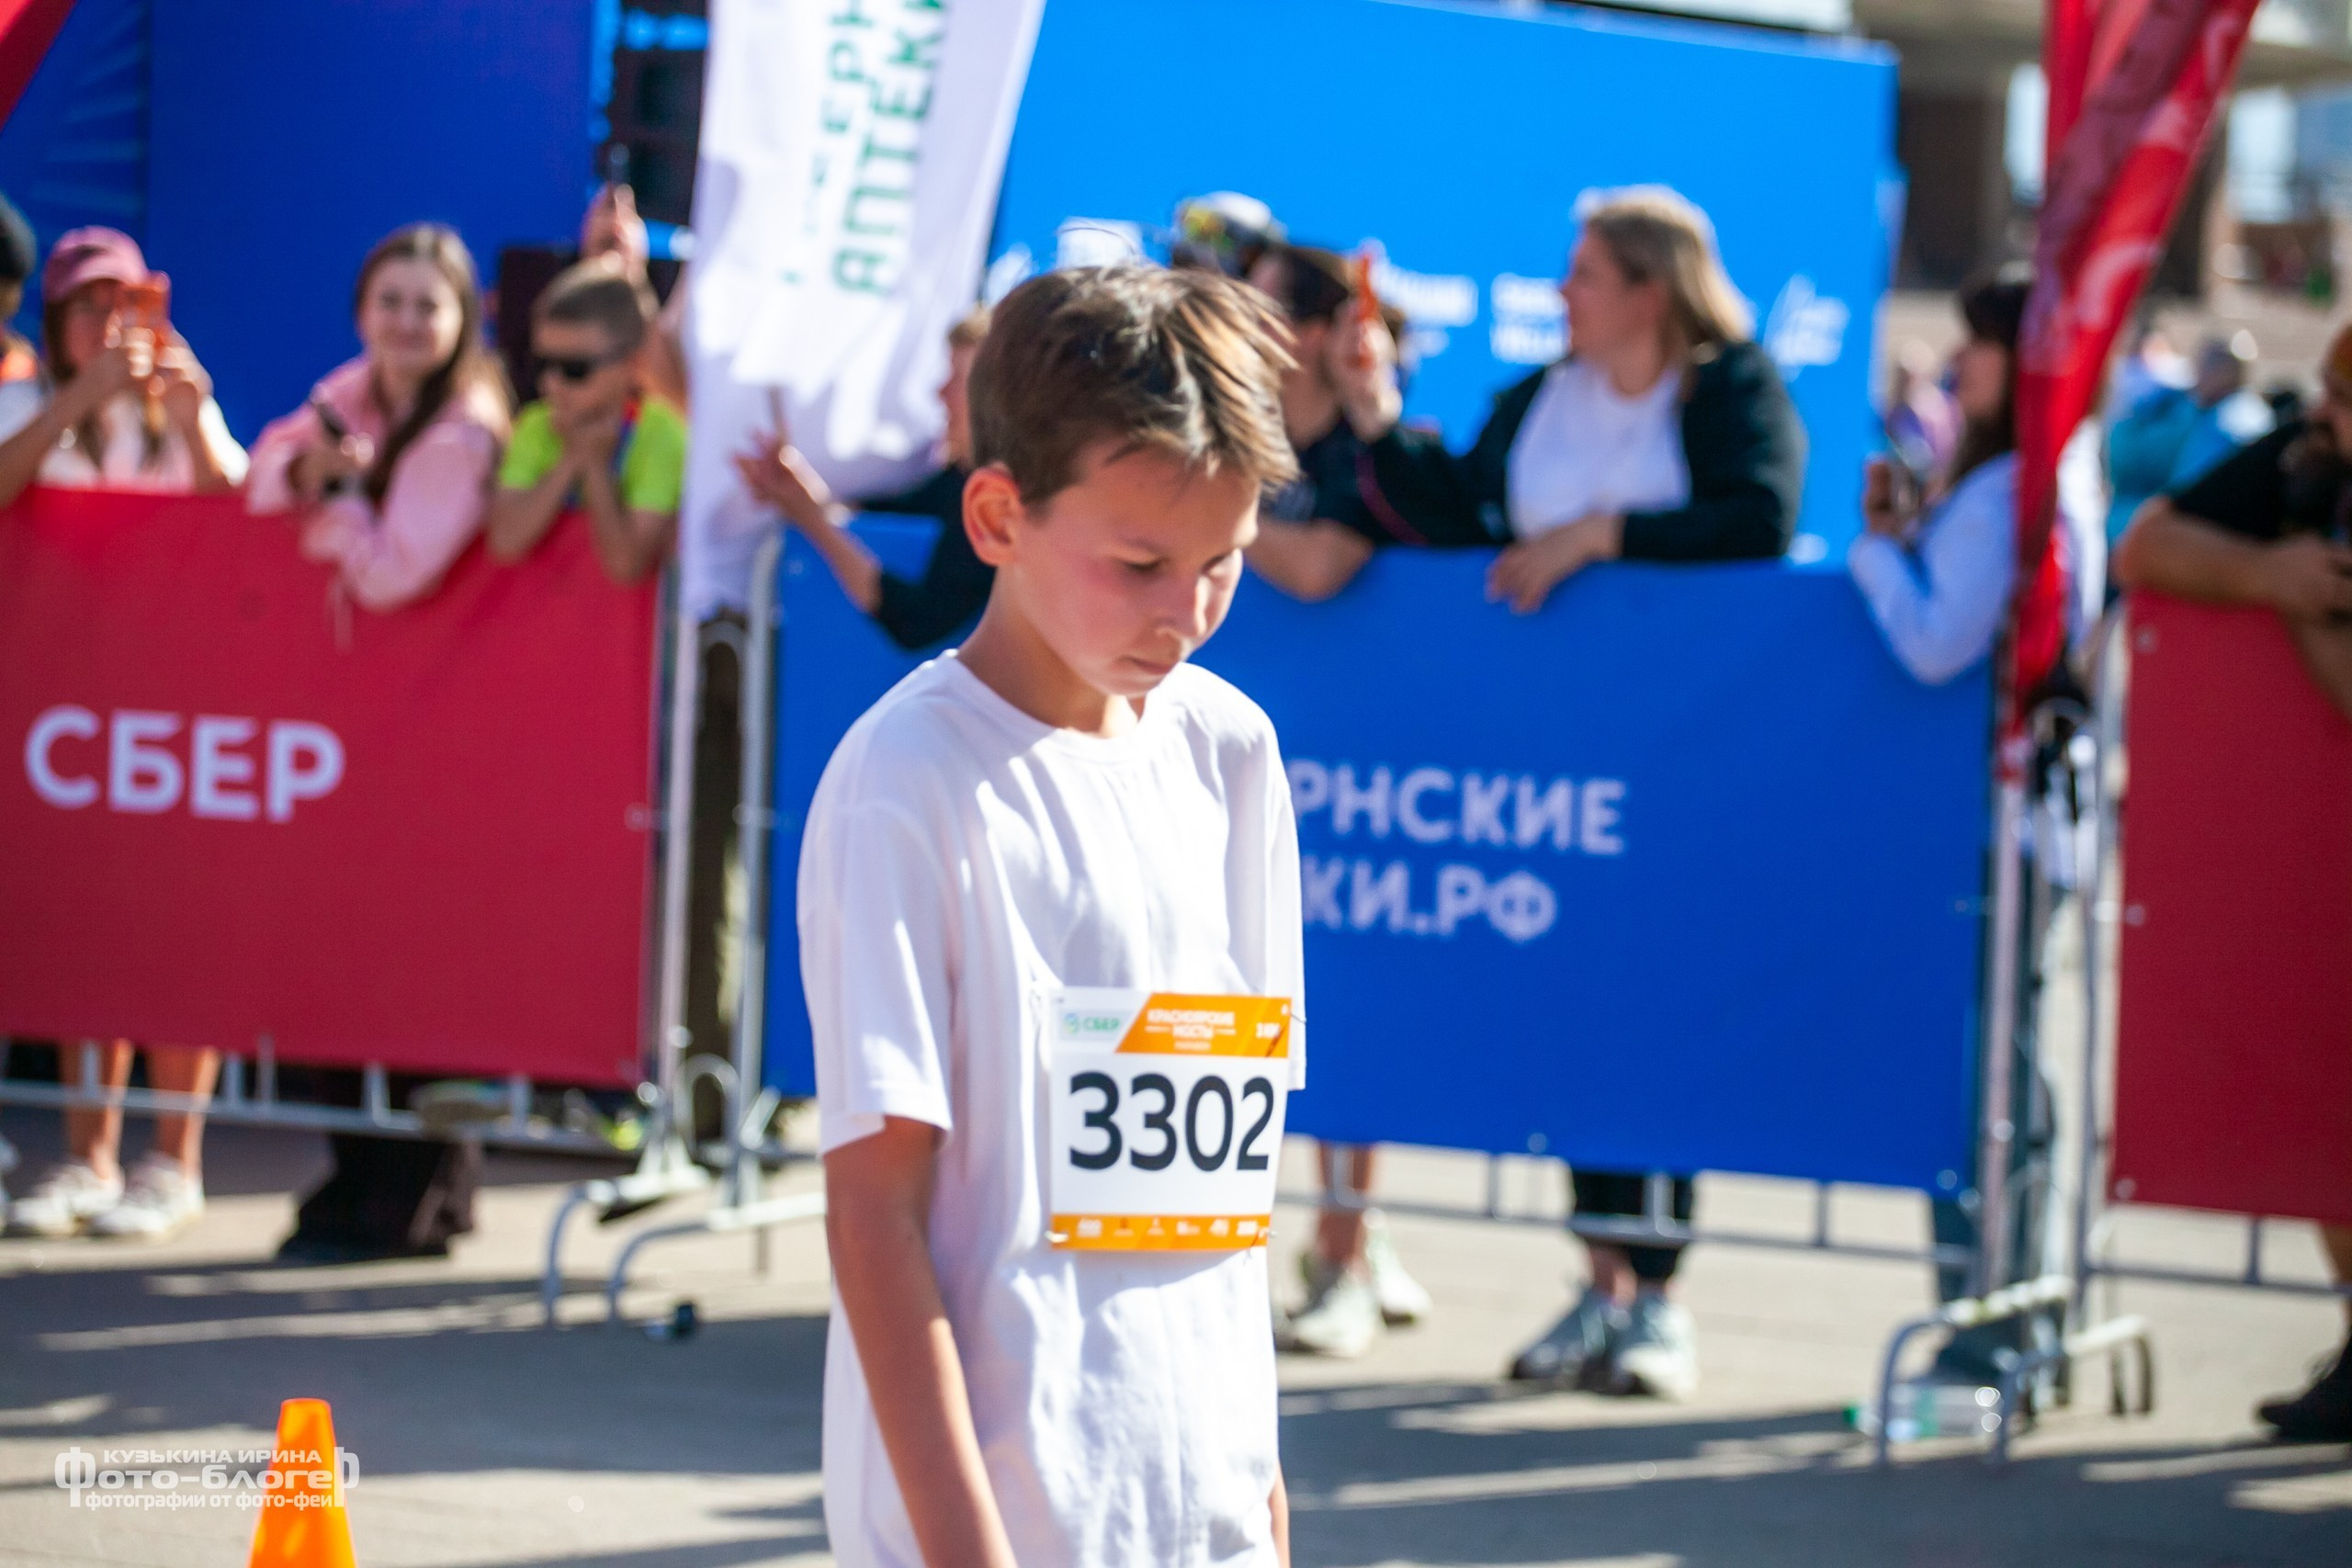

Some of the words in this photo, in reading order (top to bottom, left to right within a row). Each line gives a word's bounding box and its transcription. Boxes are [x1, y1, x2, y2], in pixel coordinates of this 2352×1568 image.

[24, 704, 345, 823] СБЕР
[1287, 759, 1627, 855] РНСКИЕ
[1301, 854, 1557, 944] КИ.РФ
[1069, 1071, 1274, 1172] 3302
